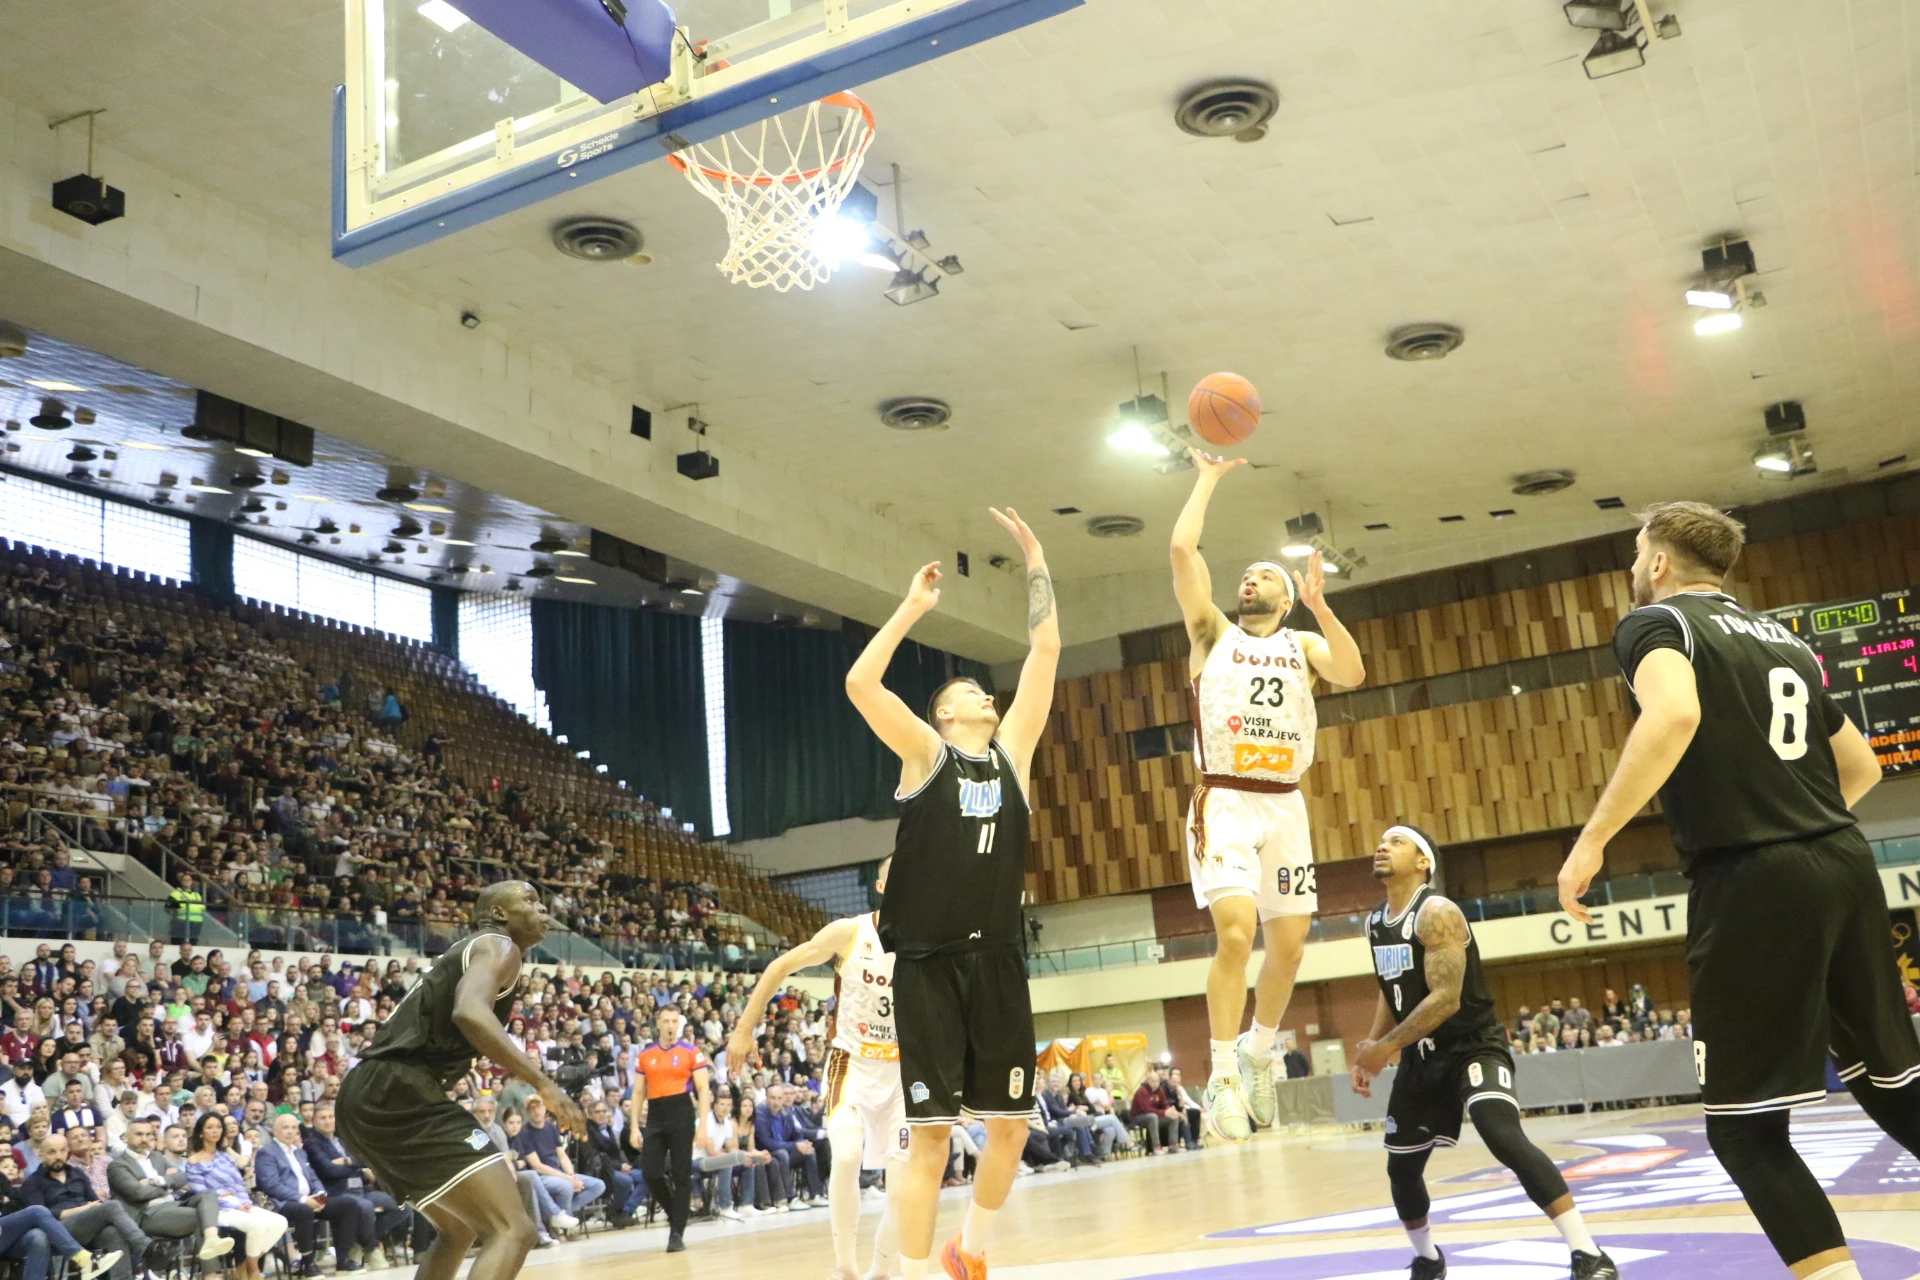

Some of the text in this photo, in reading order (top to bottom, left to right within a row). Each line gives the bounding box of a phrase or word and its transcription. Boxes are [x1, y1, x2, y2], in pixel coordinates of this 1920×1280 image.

[580, 132, 619, 152] Schelde
[580, 143, 614, 160] Sports
[1881, 589, 1910, 600] FOULS
[1776, 609, 1804, 620] FOULS
[1816, 603, 1874, 631] 07:40
[1838, 658, 1870, 669] PERIOD
[1250, 676, 1284, 707] 23
[1863, 684, 1892, 694] PLAYER
[1243, 715, 1272, 728] VISIT
[1769, 667, 1809, 760] 8
[1243, 727, 1302, 742] SARAJEVO
[977, 822, 996, 853] 11
[1294, 863, 1317, 895] 23
[869, 1024, 892, 1033] VISIT
[1498, 1066, 1511, 1089] 0
